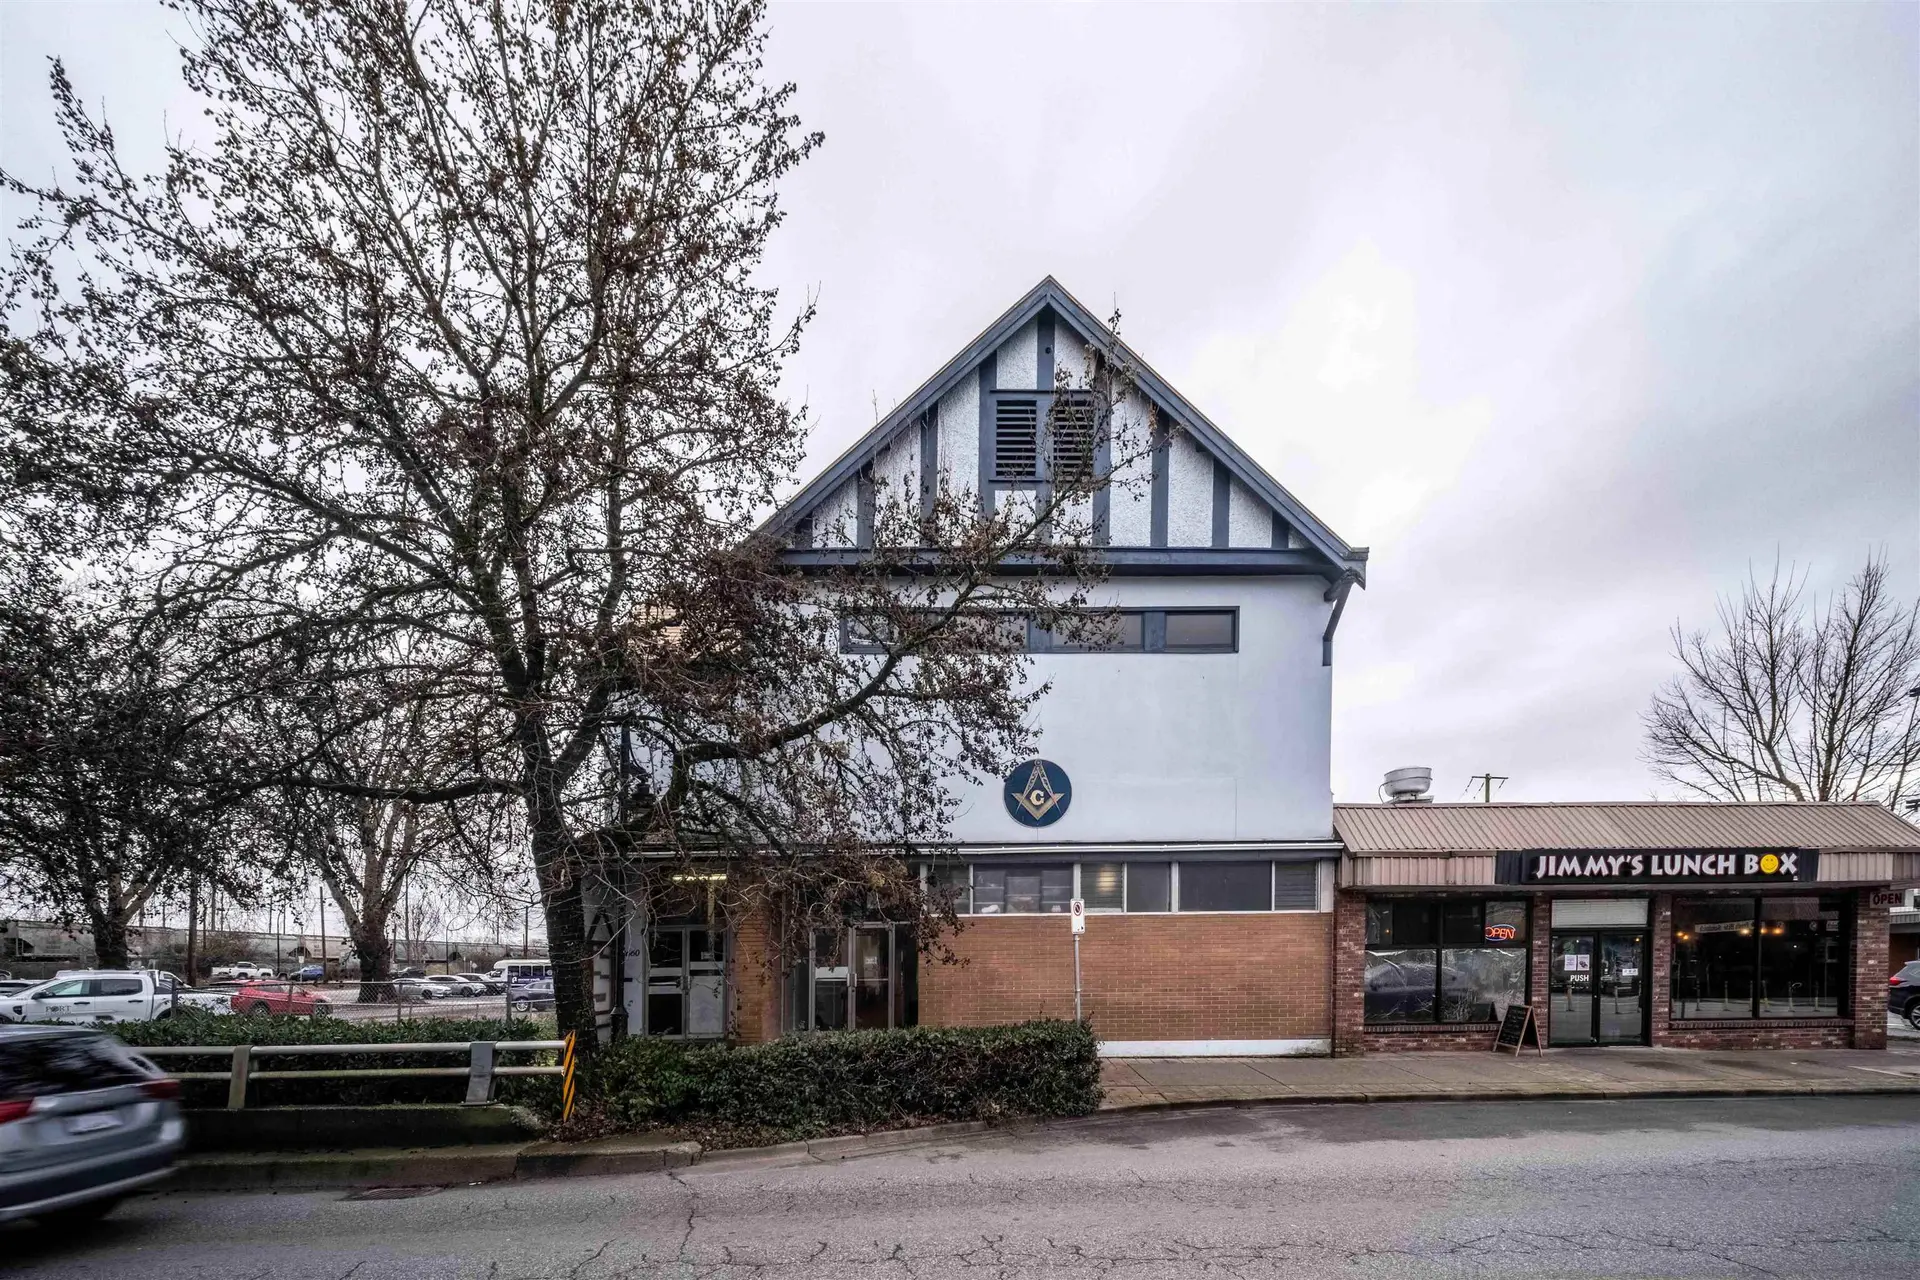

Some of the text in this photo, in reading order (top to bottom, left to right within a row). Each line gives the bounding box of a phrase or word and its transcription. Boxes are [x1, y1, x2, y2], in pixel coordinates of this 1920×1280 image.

[1536, 853, 1798, 879] JIMMY'S LUNCH BOX
[1873, 892, 1903, 906] OPEN
[1485, 926, 1515, 939] OPEN
[1570, 974, 1590, 982] PUSH
